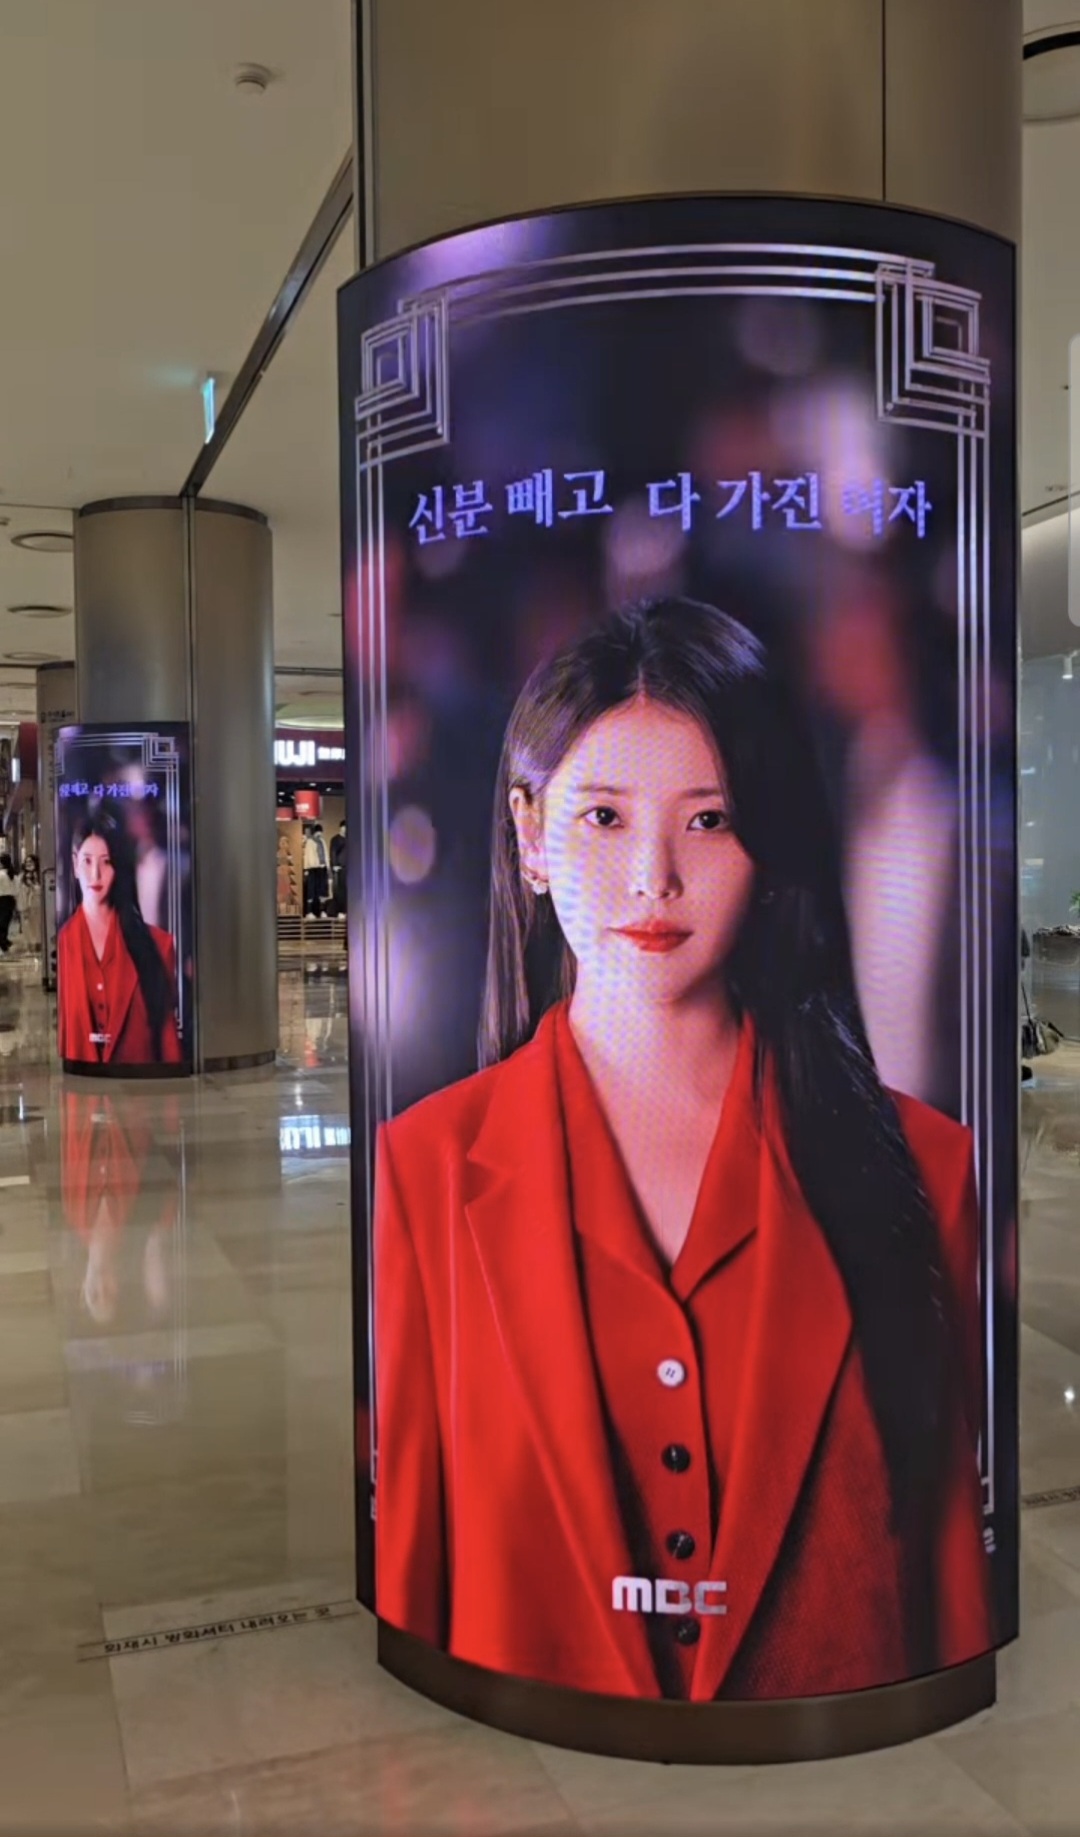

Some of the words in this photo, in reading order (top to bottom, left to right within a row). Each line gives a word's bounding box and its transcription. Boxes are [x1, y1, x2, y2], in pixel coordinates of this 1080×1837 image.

[408, 480, 493, 545] 신분
[507, 468, 614, 528] 빼고
[646, 472, 700, 532] 다
[715, 470, 822, 531] 가진
[274, 739, 315, 766] UJI
[612, 1576, 727, 1615] MBC
